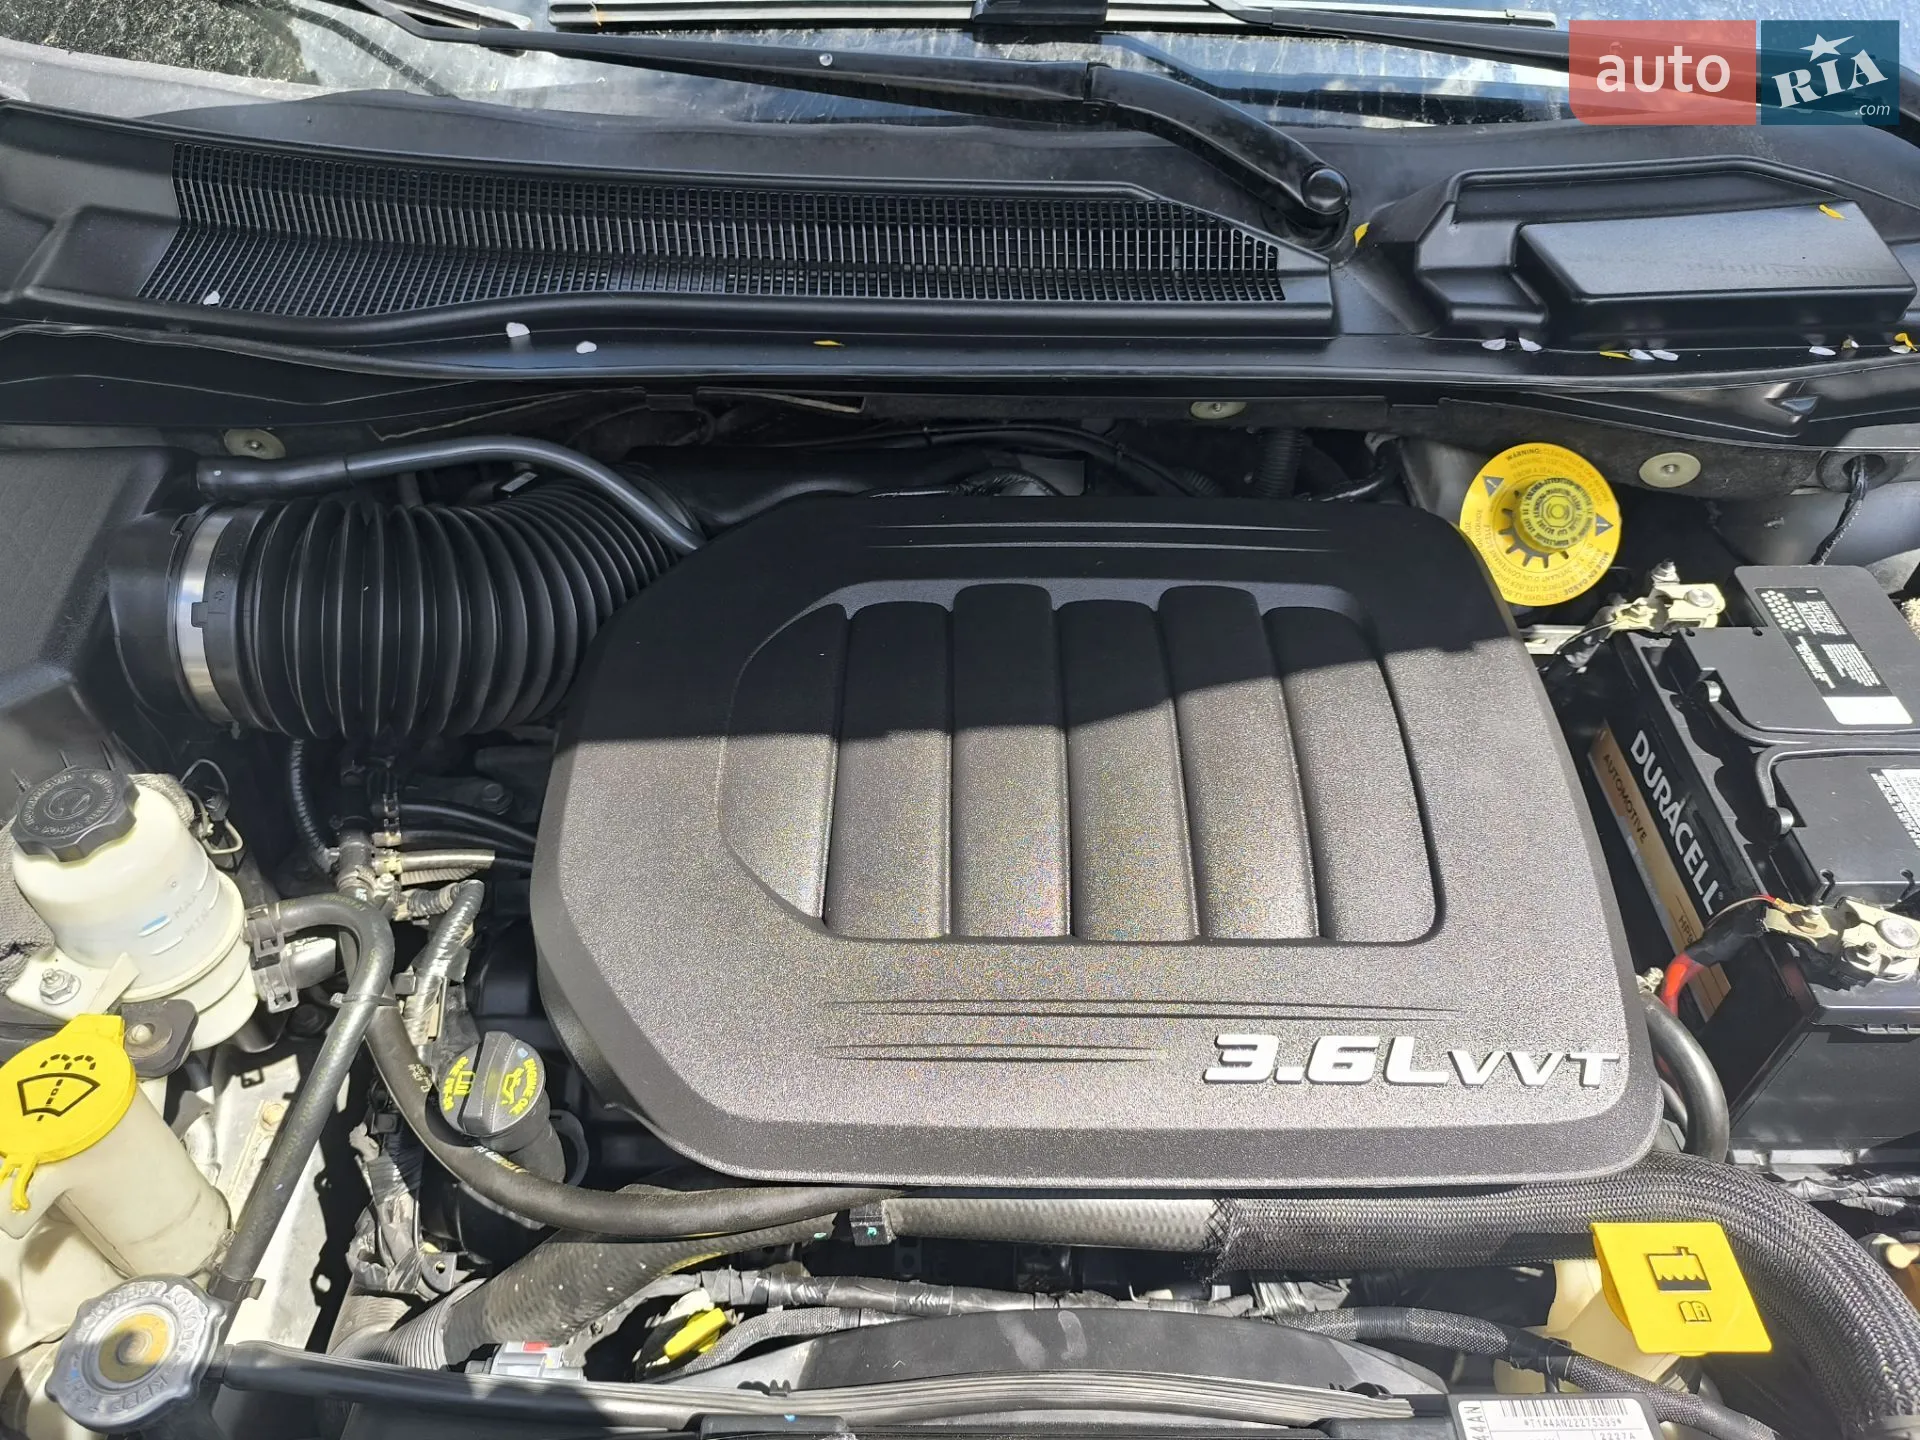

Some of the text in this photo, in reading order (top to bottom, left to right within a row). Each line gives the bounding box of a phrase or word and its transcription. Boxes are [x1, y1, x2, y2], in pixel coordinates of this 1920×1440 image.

[1603, 754, 1648, 844] AUTOMOTIVE
[1630, 729, 1719, 916] DURACELL
[1447, 1051, 1620, 1088] VVT
